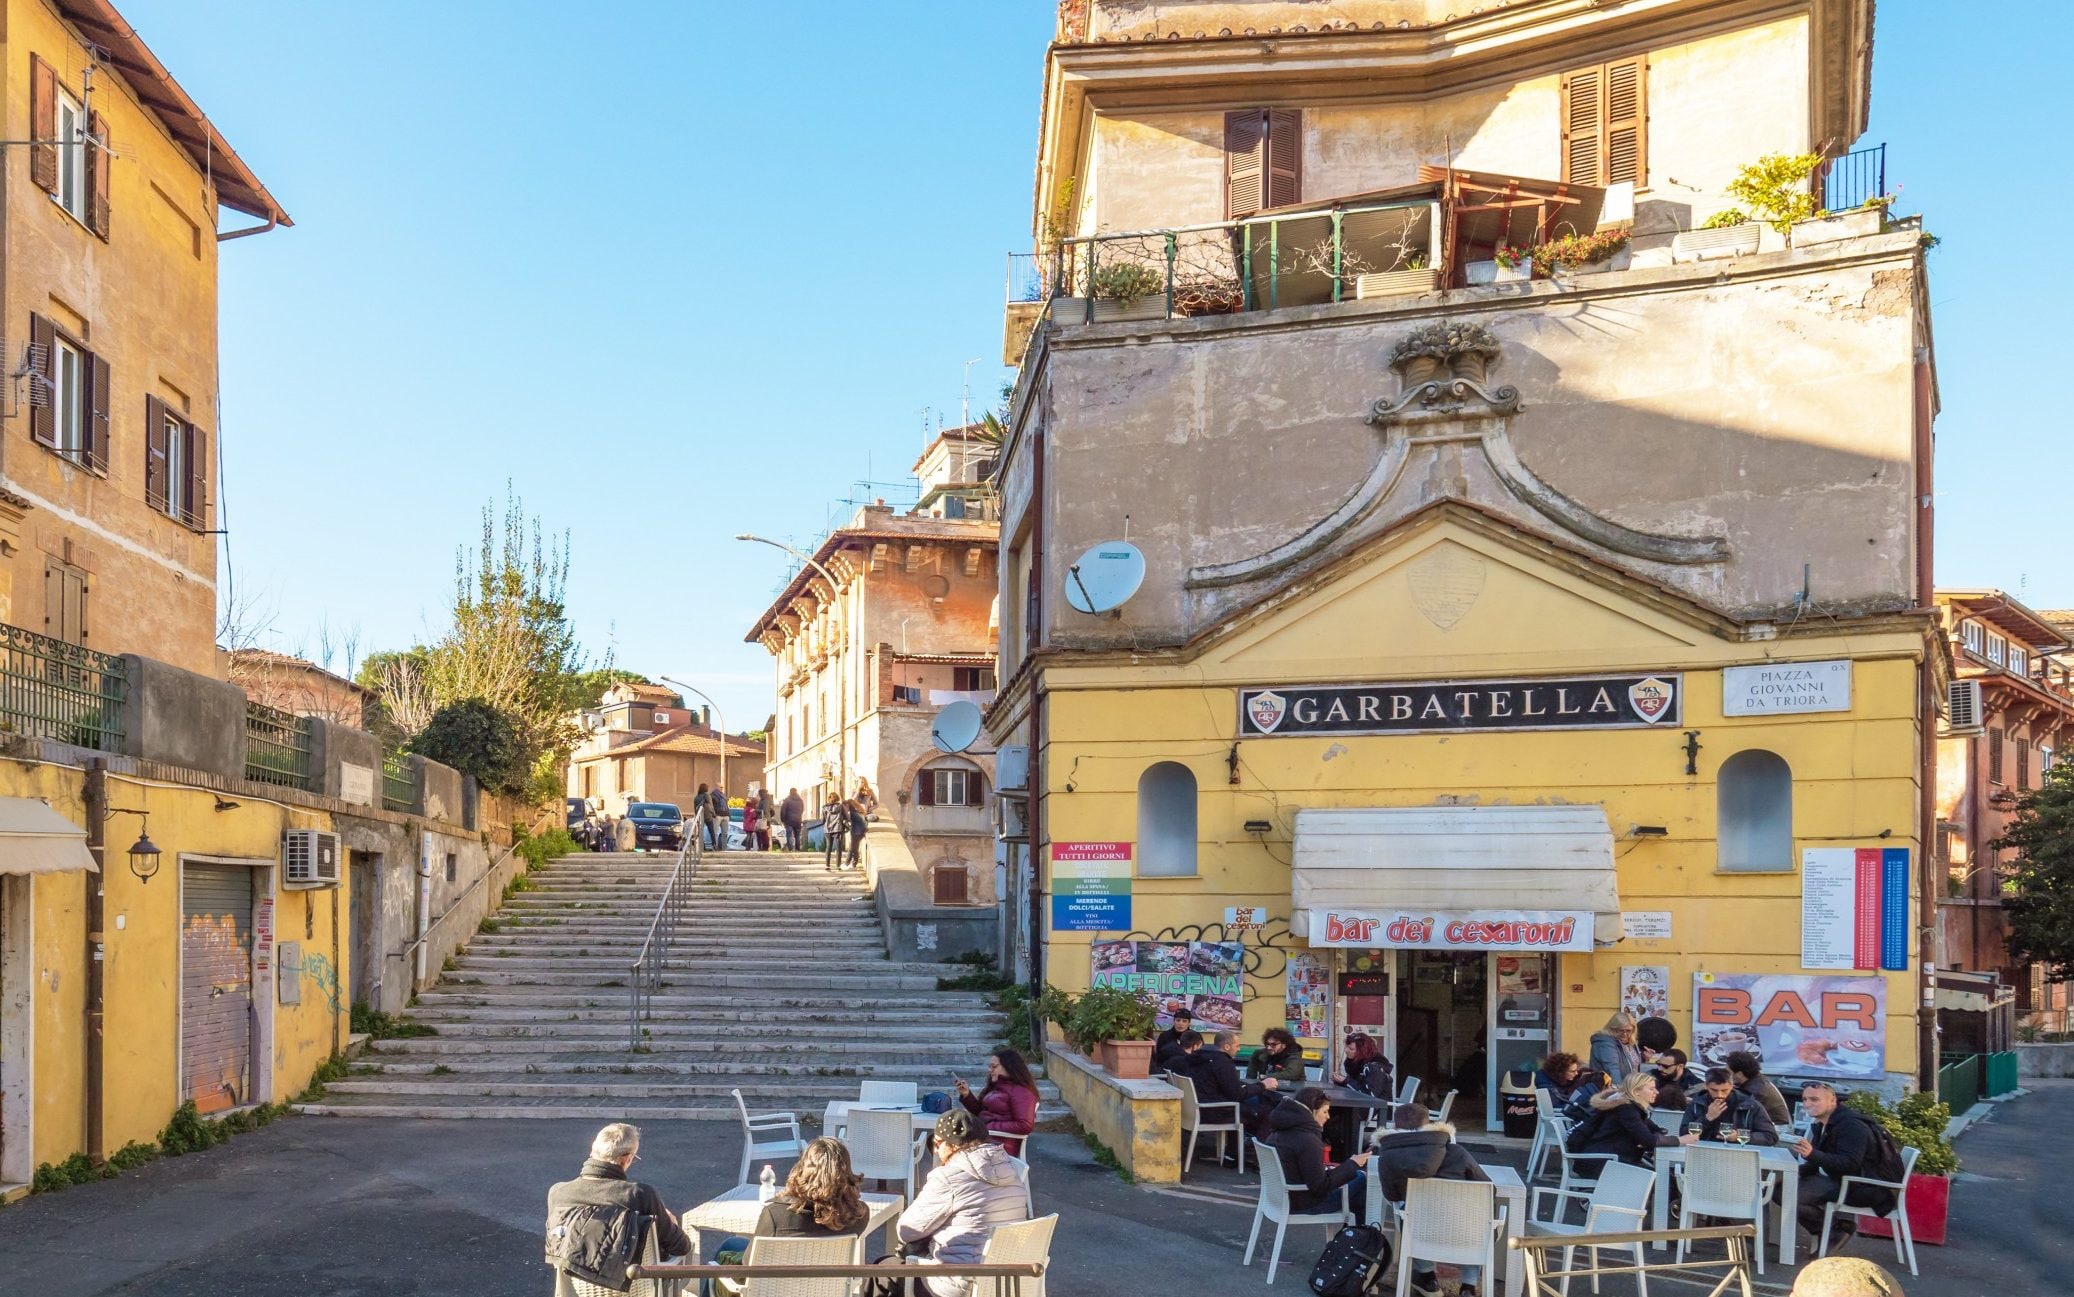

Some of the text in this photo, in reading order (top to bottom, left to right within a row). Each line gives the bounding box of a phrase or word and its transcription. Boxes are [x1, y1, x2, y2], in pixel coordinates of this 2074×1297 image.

[1761, 670, 1813, 682] PIAZZA
[1750, 682, 1824, 695] GIOVANNI
[1292, 686, 1617, 724] GARBATELLA
[1746, 694, 1829, 708] DA TRIORA
[1236, 906, 1256, 915] bar
[1225, 921, 1266, 930] cesaroni
[1235, 915, 1252, 923] dei
[1325, 912, 1577, 946] bar dei cesaroni
[1092, 971, 1242, 996] APERICENA
[1698, 987, 1877, 1031] BAR
